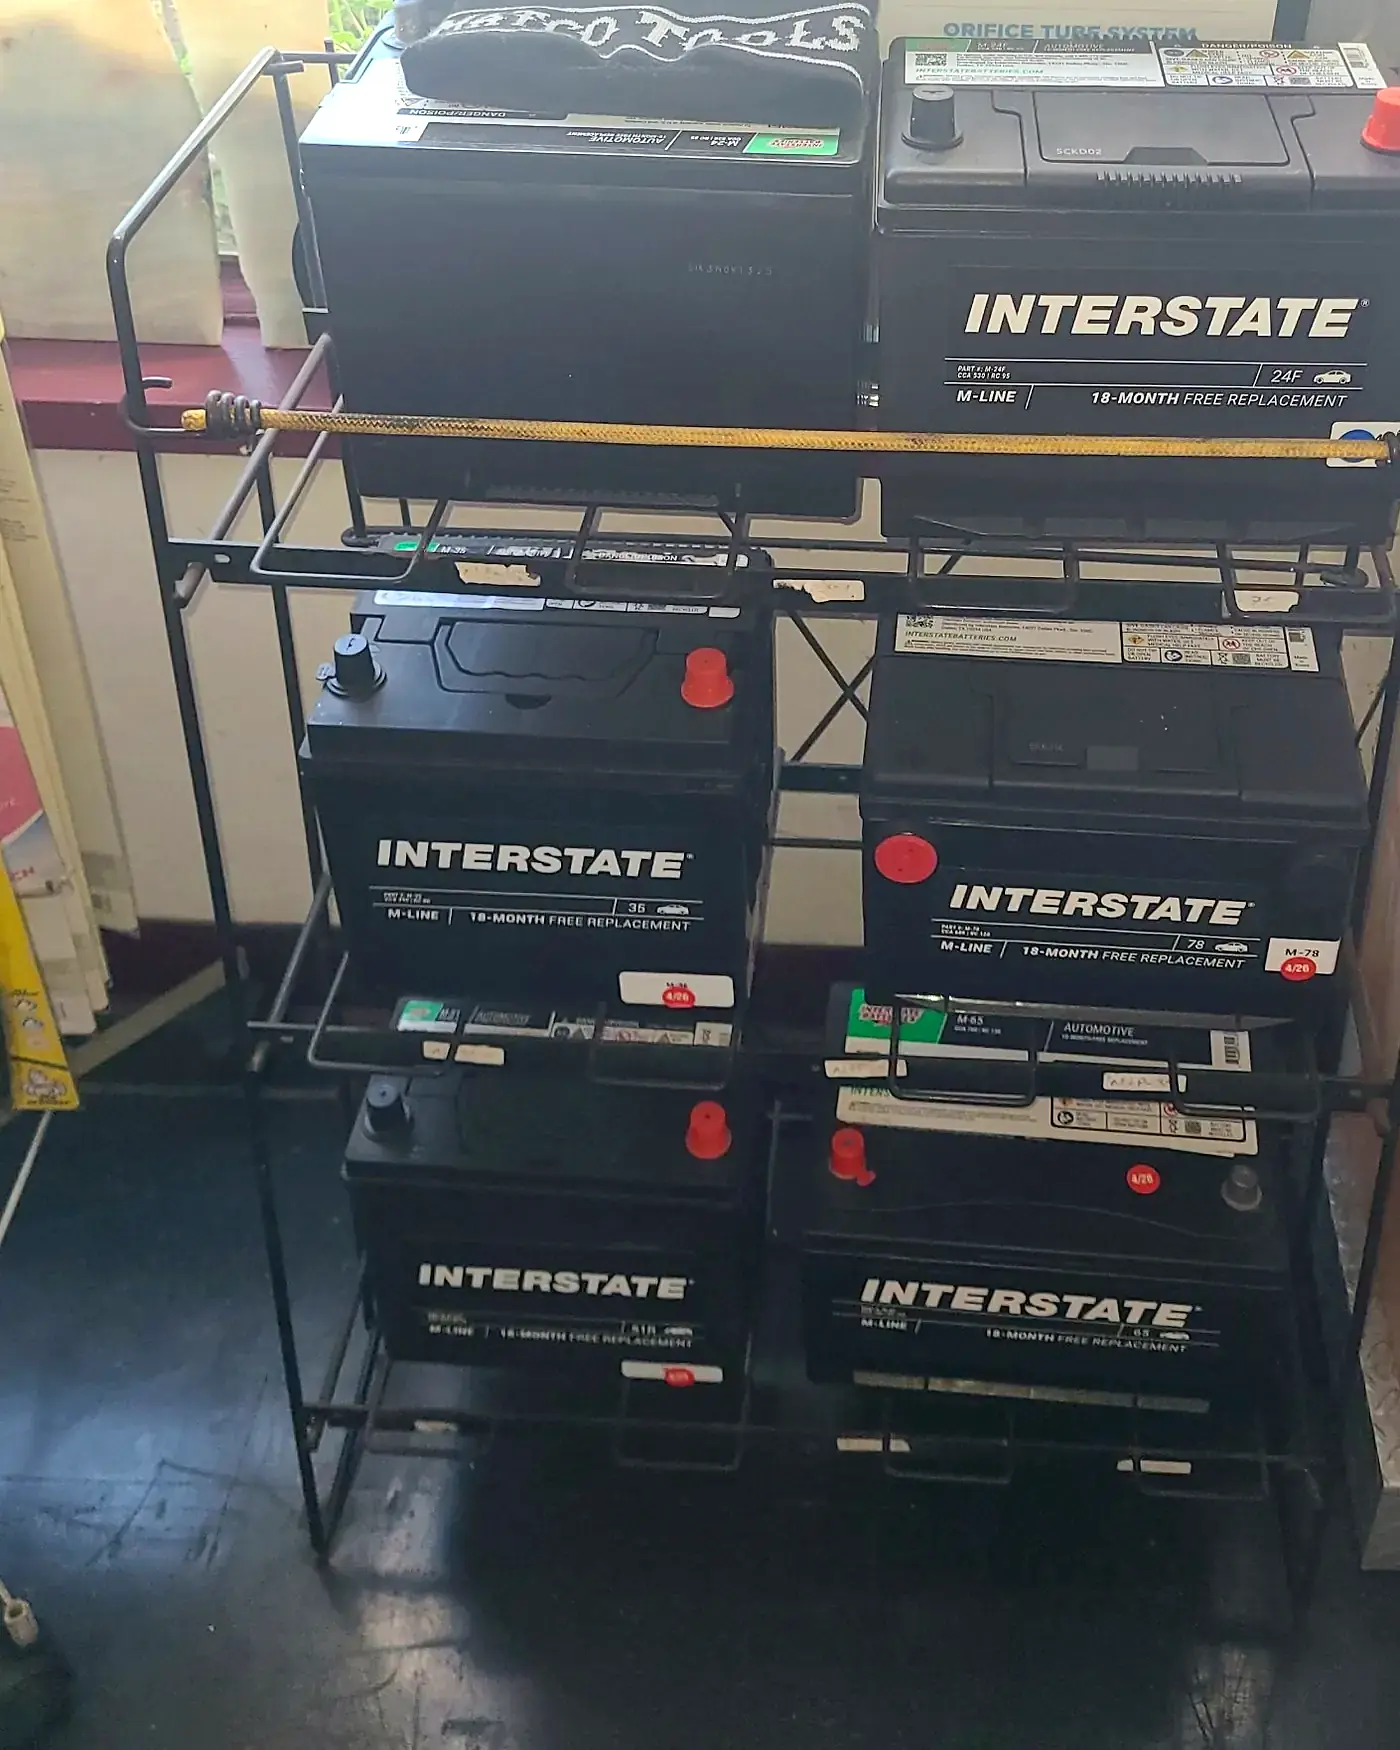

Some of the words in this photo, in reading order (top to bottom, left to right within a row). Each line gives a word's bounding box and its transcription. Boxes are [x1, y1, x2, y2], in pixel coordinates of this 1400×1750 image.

[943, 23, 1035, 38] ORIFICE
[409, 108, 507, 118] DANGER/POISON
[589, 134, 665, 144] AUTOMOTIVE
[710, 139, 740, 148] M-24
[965, 293, 1359, 338] INTERSTATE
[957, 365, 975, 373] PART
[1270, 369, 1303, 383] 24F
[956, 389, 1017, 403] M-LINE
[1091, 391, 1180, 405] 18-MONTH
[1183, 393, 1224, 406] FREE
[1227, 394, 1349, 408] REPLACEMENT
[377, 839, 687, 880] INTERSTATE
[627, 902, 646, 914] 35
[949, 884, 1248, 925] INTERSTATE
[387, 908, 440, 921] M-LINE
[470, 911, 546, 926] 18-MONTH
[549, 914, 584, 928] FREE
[587, 916, 691, 932] REPLACEMENT
[940, 940, 993, 954] M-LINE
[1187, 939, 1205, 950] 78
[1022, 946, 1099, 960] 18-MONTH
[1102, 951, 1138, 963] FREE
[1140, 953, 1246, 970] REPLACEMENT
[1285, 948, 1320, 958] M-78
[1063, 1021, 1135, 1037] AUTOMOTIVE
[418, 1263, 688, 1300] INTERSTATE
[860, 1278, 1194, 1328] INTERSTATE
[860, 1317, 907, 1330] M-LINE
[985, 1329, 1055, 1342] 18-MONTH
[1057, 1334, 1089, 1346] FREE
[1091, 1337, 1187, 1353] REPLACEMENT
